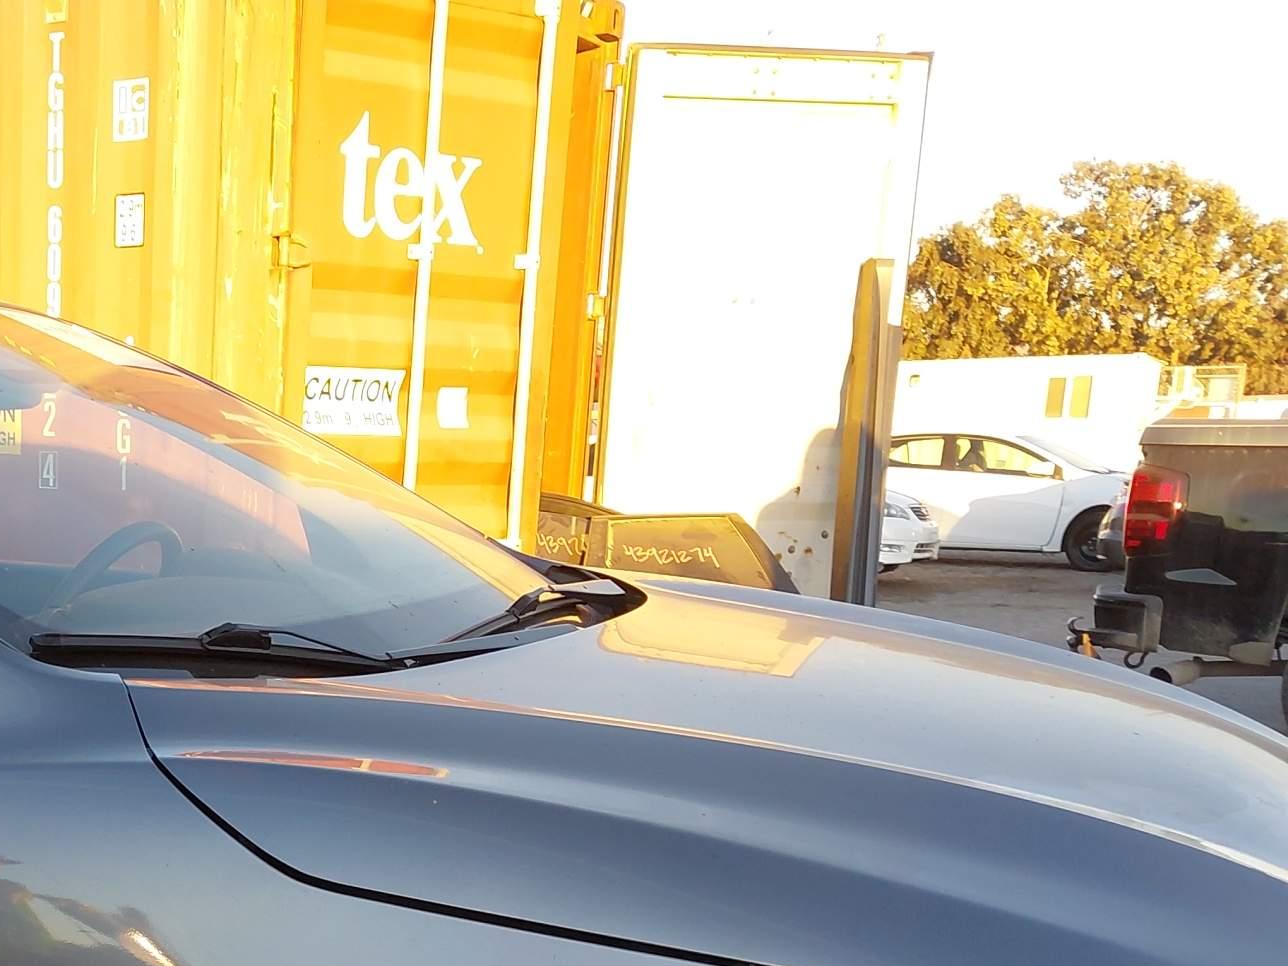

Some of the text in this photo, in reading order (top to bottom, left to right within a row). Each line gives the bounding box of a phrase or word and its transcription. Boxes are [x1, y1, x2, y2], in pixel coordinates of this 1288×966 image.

[47, 31, 66, 189] TGHU
[304, 377, 397, 403] CAUTION
[363, 411, 394, 426] HIGH
[622, 544, 721, 569] 43921274
